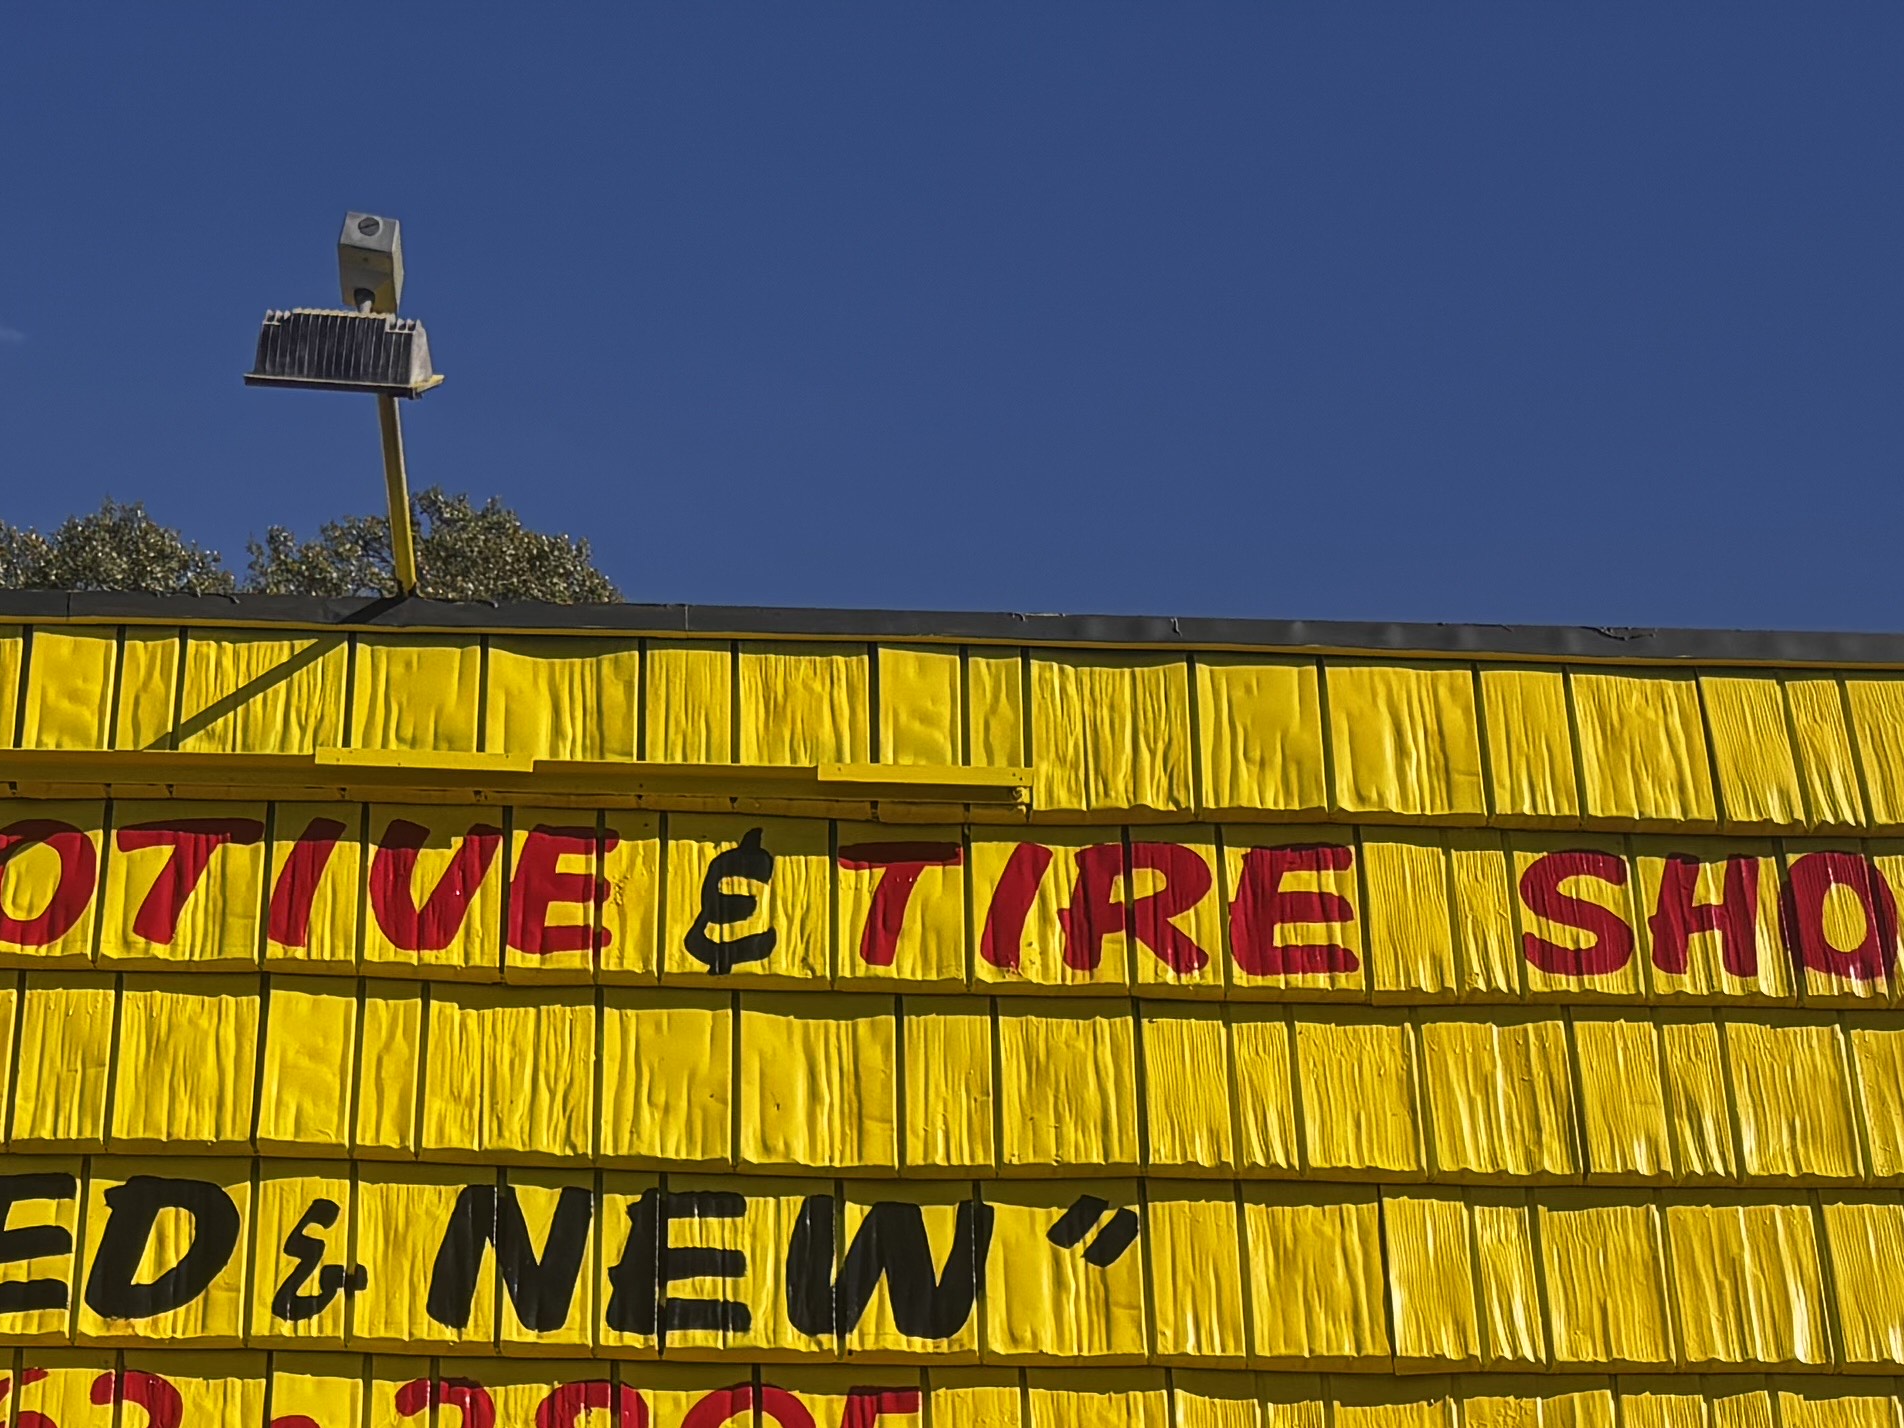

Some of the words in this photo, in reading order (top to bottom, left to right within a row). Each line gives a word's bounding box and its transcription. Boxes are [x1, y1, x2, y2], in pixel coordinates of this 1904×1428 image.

[685, 828, 776, 975] &
[839, 840, 1360, 977] TIRE
[272, 1200, 368, 1324] &
